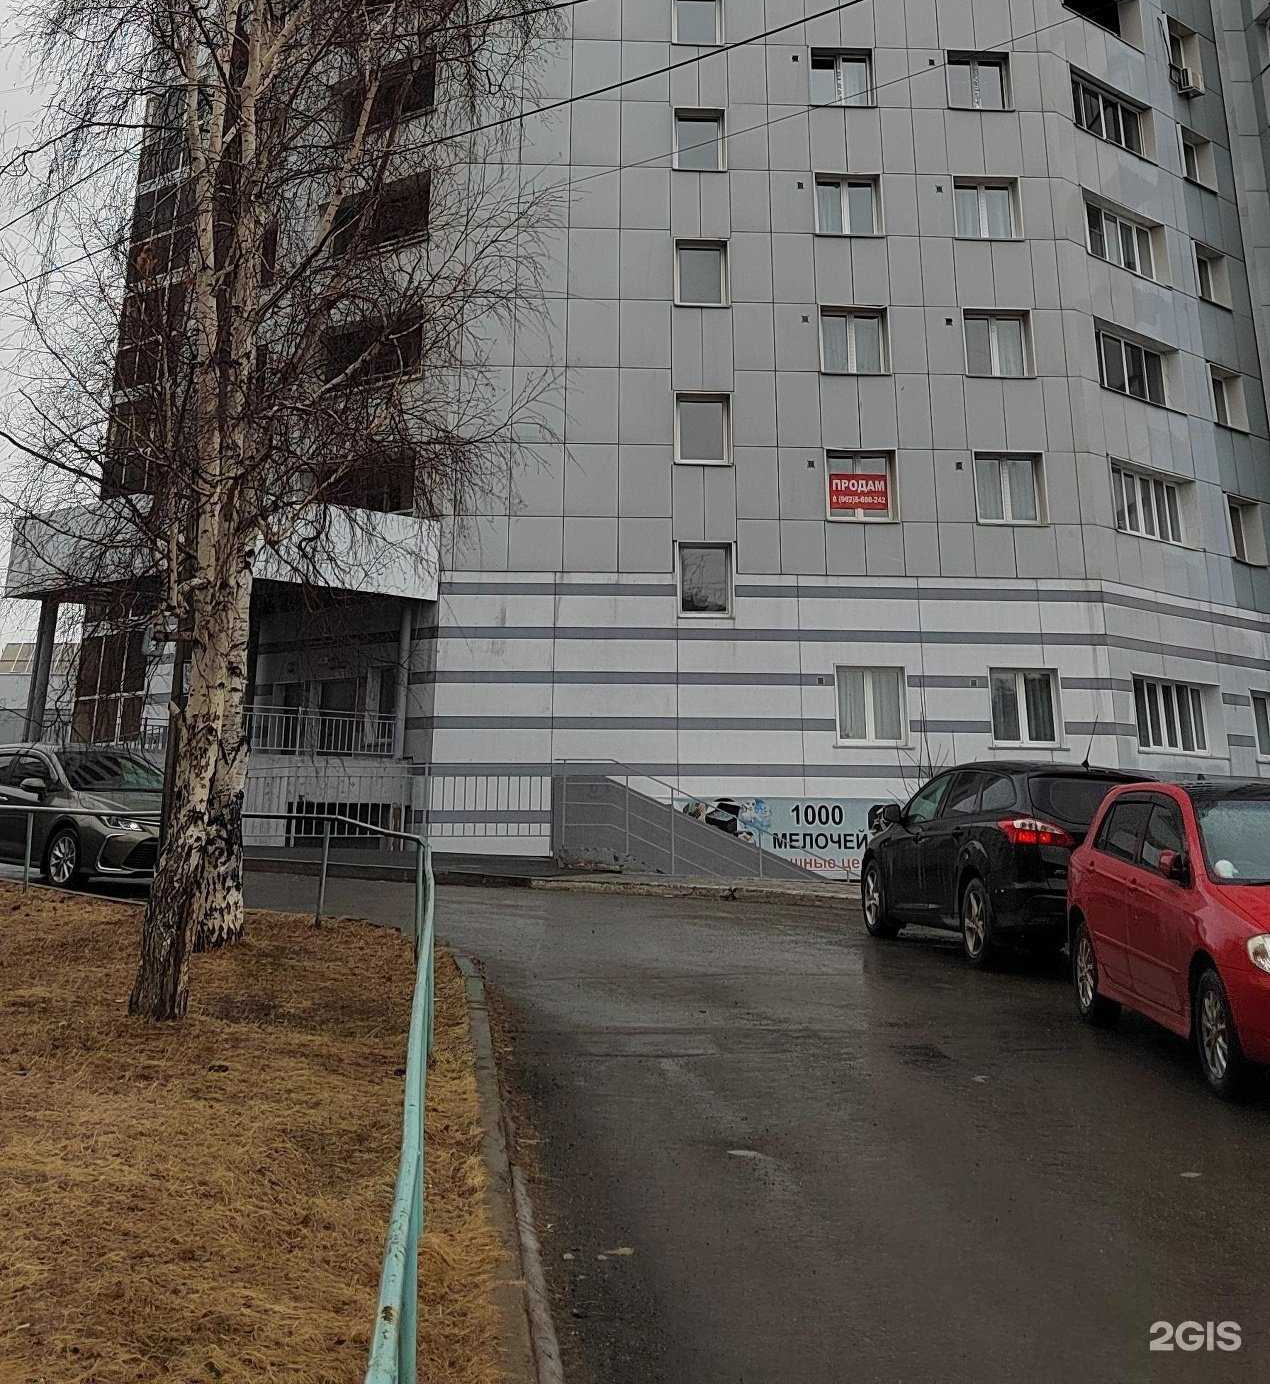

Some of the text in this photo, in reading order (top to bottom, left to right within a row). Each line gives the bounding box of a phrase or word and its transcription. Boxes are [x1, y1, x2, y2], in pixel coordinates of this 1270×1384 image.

[832, 479, 885, 493] ПРОДАМ
[791, 804, 843, 826] 1000
[773, 829, 868, 849] МЕЛОЧЕЙ
[842, 857, 861, 872] це
